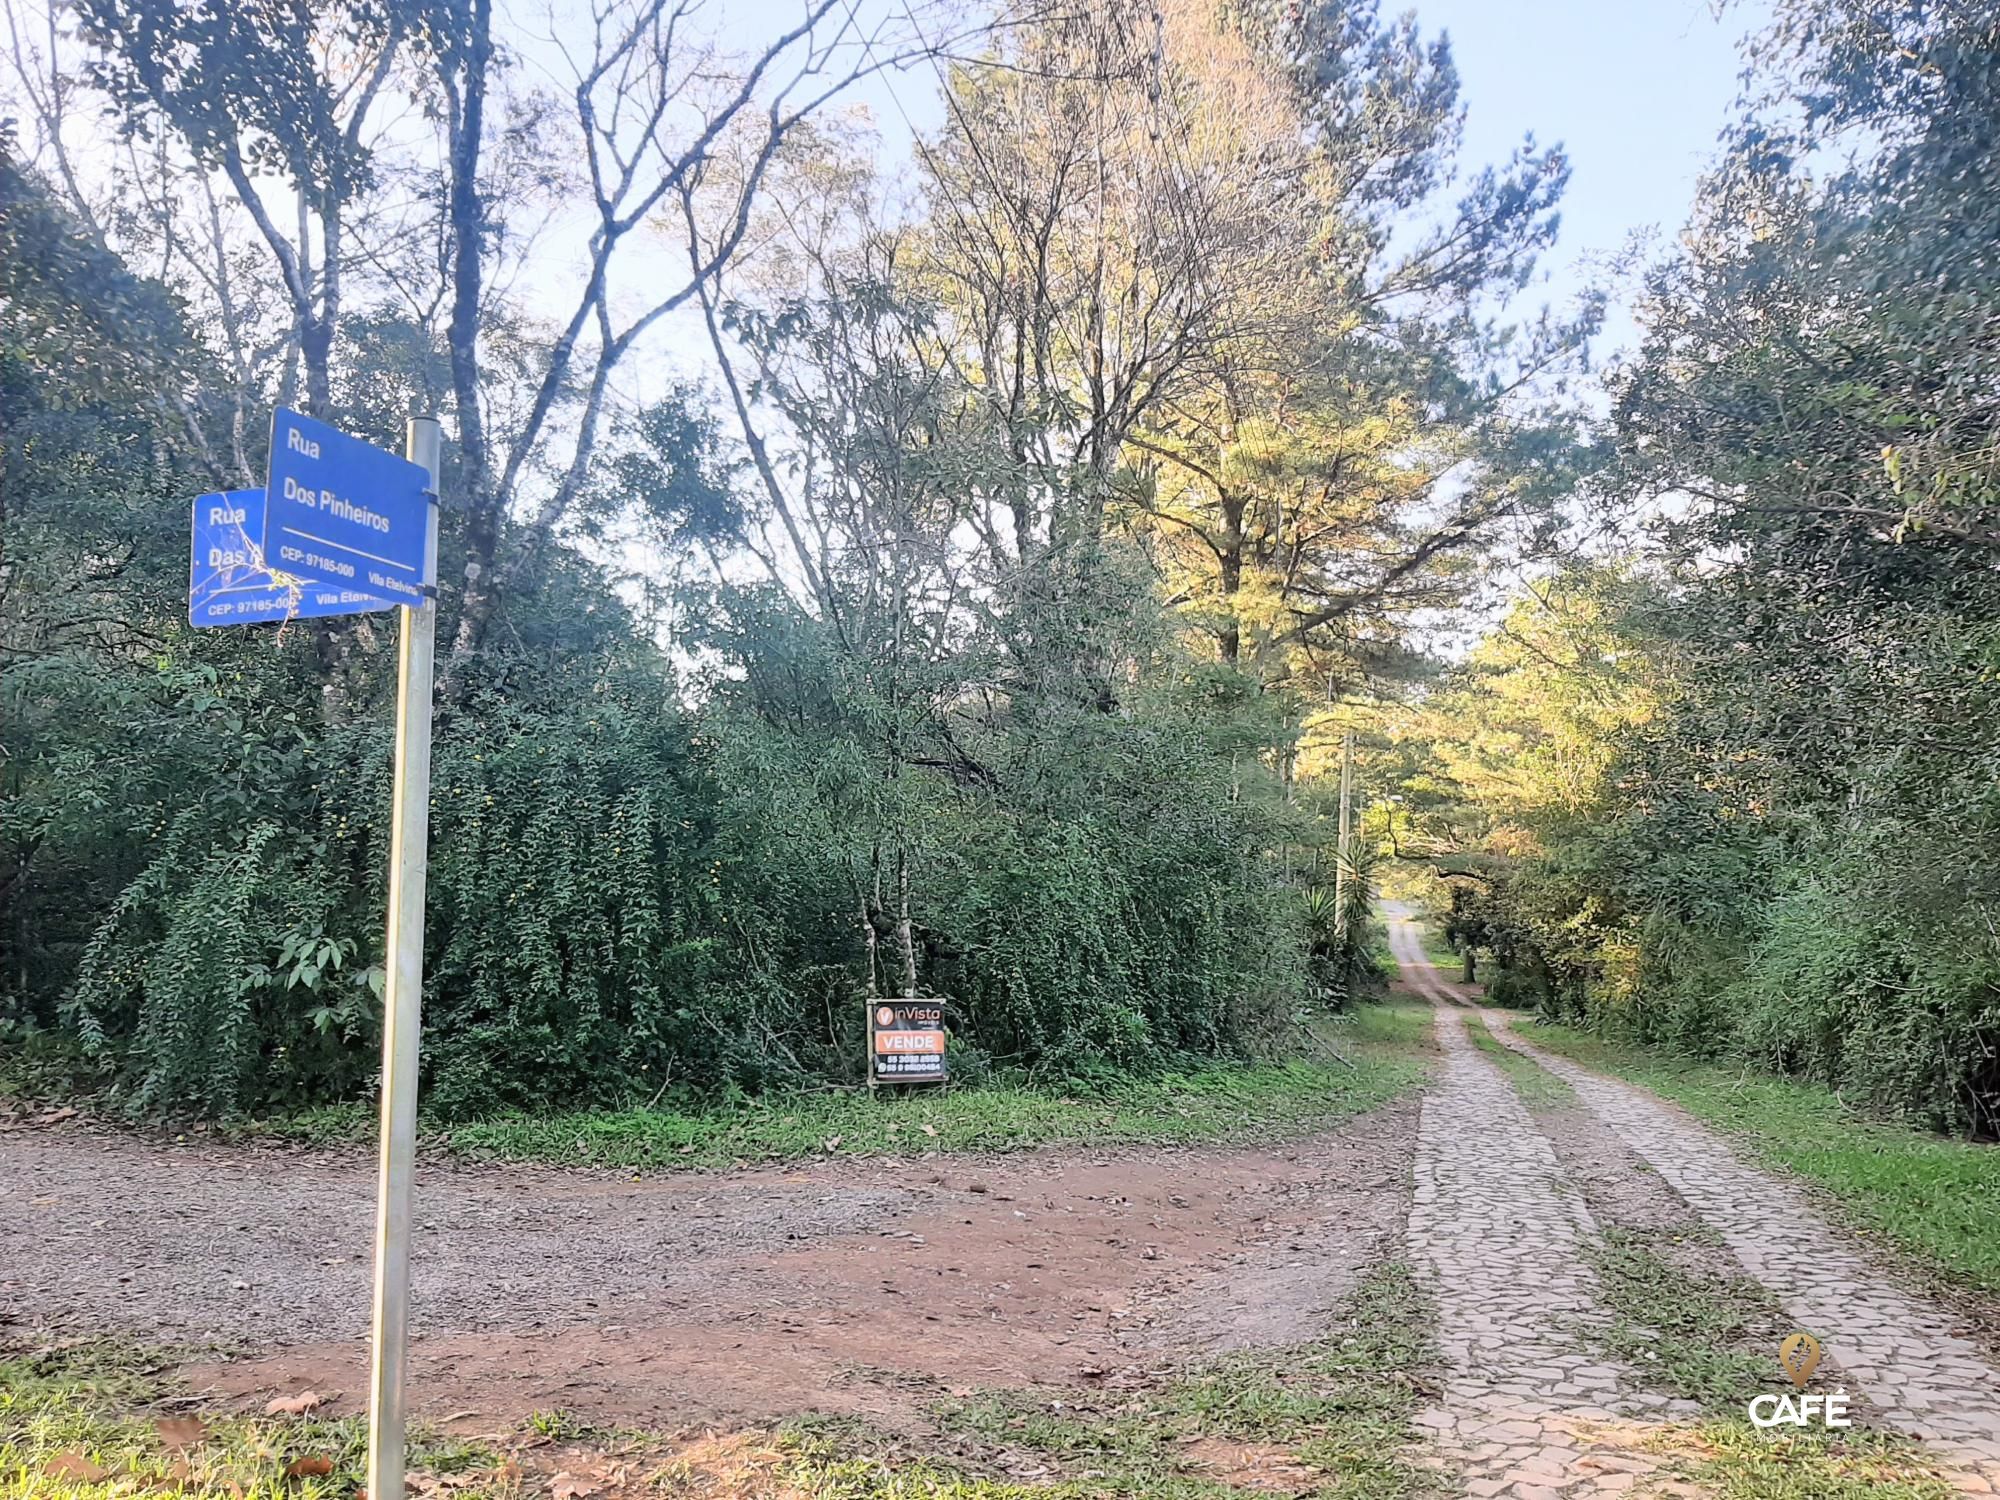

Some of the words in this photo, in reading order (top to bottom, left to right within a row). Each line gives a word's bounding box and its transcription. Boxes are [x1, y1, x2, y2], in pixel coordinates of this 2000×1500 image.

[287, 428, 320, 460] Rua
[283, 477, 316, 508] Dos
[319, 490, 390, 534] Pinheiros
[209, 507, 246, 526] Rua
[209, 548, 246, 567] Das
[280, 546, 305, 563] CEP:
[306, 553, 355, 578] 97185-000
[368, 571, 385, 587] Vila
[385, 577, 418, 597] Etelvina
[208, 603, 235, 616] CEP:
[315, 592, 338, 606] Vila
[895, 1007, 940, 1019] inVista
[883, 1035, 934, 1049] VENDE
